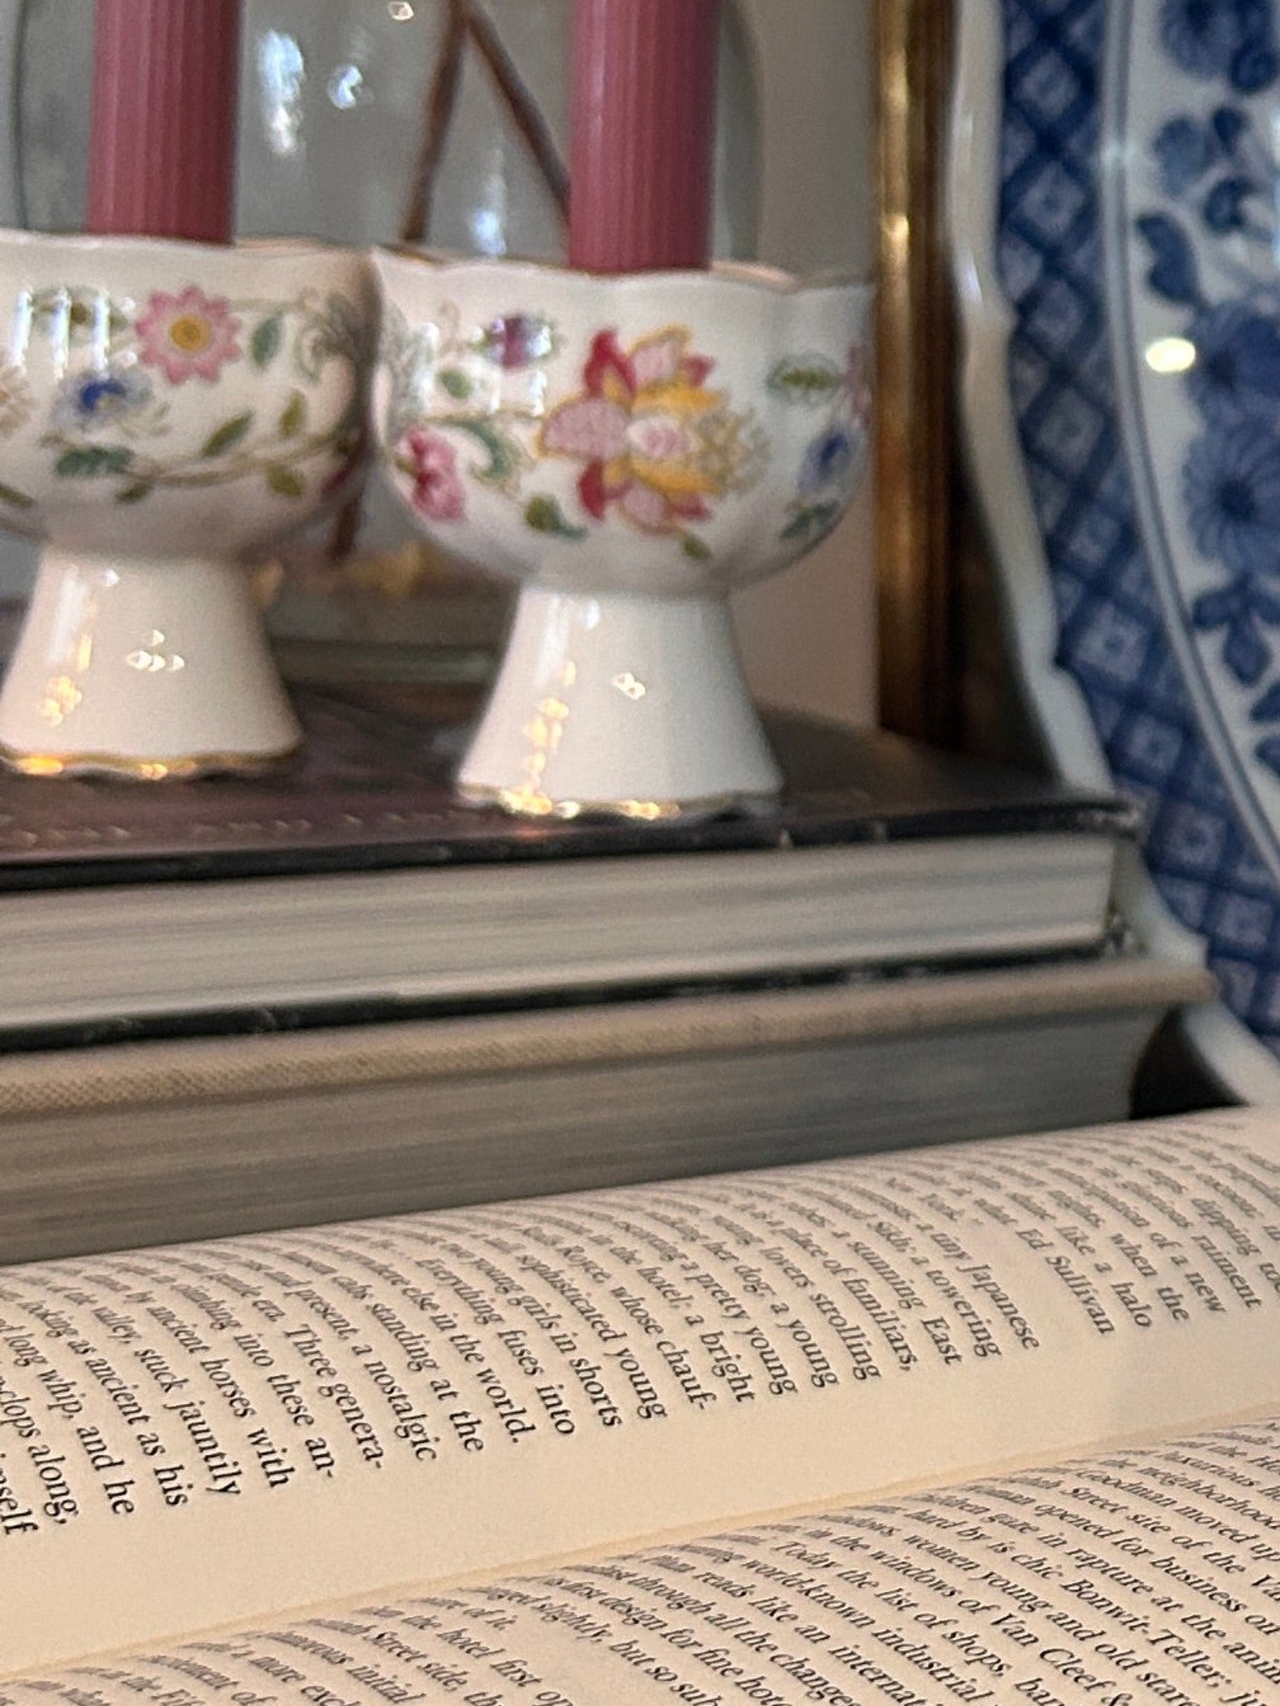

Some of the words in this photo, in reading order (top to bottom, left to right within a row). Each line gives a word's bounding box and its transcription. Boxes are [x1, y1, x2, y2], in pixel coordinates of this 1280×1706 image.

[1044, 1255, 1116, 1337] Sullivan
[1106, 1232, 1159, 1282] when
[808, 1292, 883, 1382] strolling
[840, 1267, 919, 1373] familiars,
[919, 1316, 963, 1367] East
[923, 1268, 1003, 1359] towering
[954, 1252, 1040, 1351] Japanese
[1109, 1281, 1153, 1330] halo
[281, 1323, 339, 1380] Three
[319, 1382, 385, 1470] genera-
[495, 1319, 546, 1378] fuses
[534, 1384, 576, 1437] into
[567, 1357, 623, 1428] shorts
[602, 1346, 669, 1421] young
[655, 1340, 718, 1411] chauf-
[698, 1330, 757, 1404] bright
[732, 1325, 799, 1397] young
[775, 1318, 841, 1389] young
[35, 1368, 84, 1422] whip,
[75, 1425, 122, 1473] and
[84, 1357, 152, 1427] ancient
[152, 1465, 189, 1508] his
[132, 1348, 190, 1395] stuck
[161, 1401, 244, 1496] jauntily
[198, 1357, 258, 1420] horses
[246, 1427, 295, 1489] with
[264, 1373, 316, 1428] these
[303, 1436, 335, 1479] an-
[362, 1360, 442, 1463] nostalgic
[447, 1410, 485, 1453] the
[474, 1367, 536, 1444] world.
[26, 1443, 80, 1526] along,
[1058, 1578, 1233, 1686] Bonwit-Teller;
